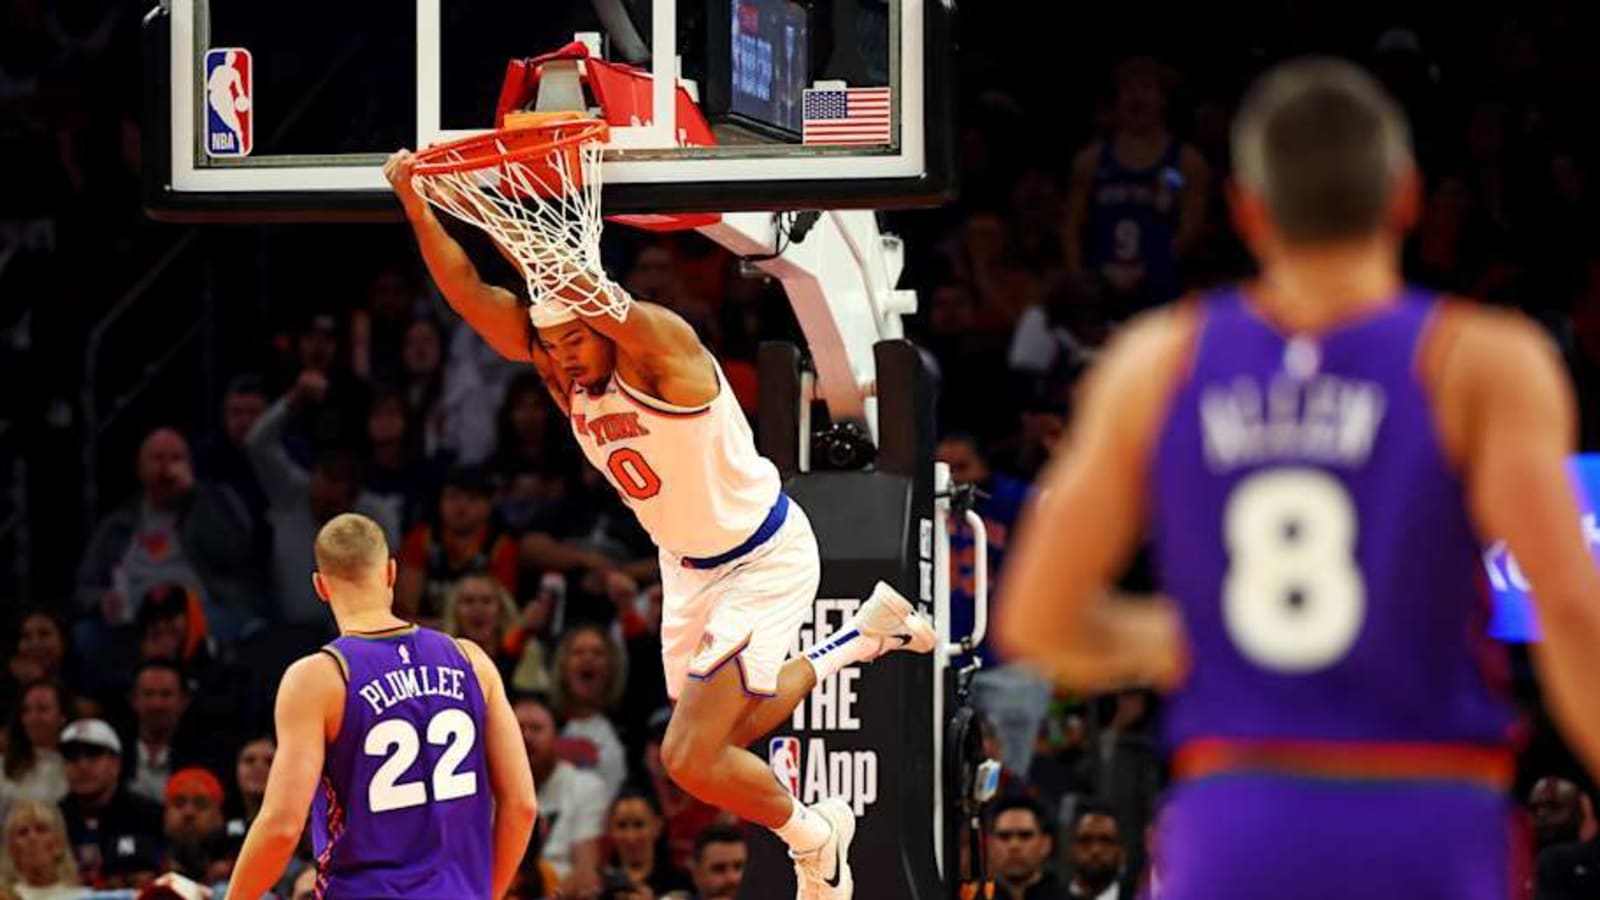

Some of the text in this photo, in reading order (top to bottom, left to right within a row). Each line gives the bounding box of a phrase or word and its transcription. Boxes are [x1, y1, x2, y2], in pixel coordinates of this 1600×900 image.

[212, 132, 235, 150] NBA
[588, 411, 650, 446] YORK
[607, 447, 662, 500] 0
[1222, 467, 1366, 672] 8
[359, 666, 465, 715] PLUMLEE
[364, 708, 477, 812] 22
[803, 738, 877, 816] App
